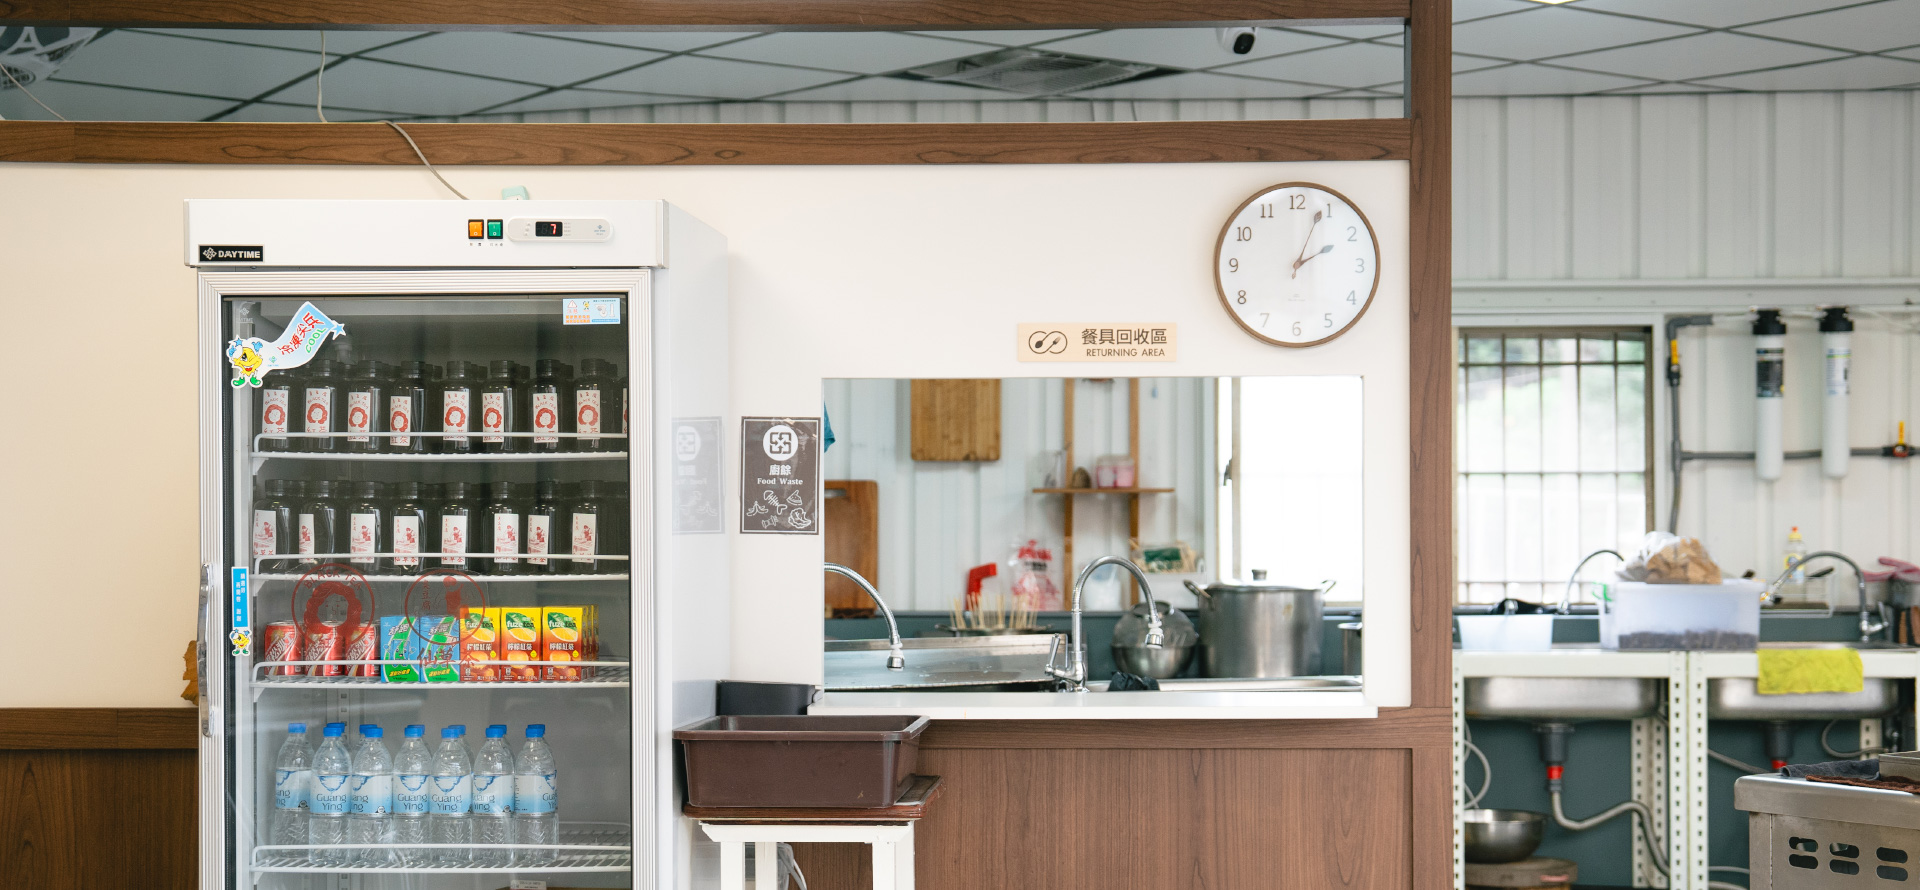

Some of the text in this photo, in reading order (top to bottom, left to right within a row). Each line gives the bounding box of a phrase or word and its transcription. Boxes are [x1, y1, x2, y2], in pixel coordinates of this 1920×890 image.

[1290, 194, 1306, 210] 12
[1260, 204, 1274, 218] 11
[1326, 204, 1332, 218] 1
[550, 224, 557, 234] 7
[1236, 226, 1252, 242] 10
[1346, 226, 1358, 242] 2
[218, 250, 260, 258] DAYTIME
[1229, 258, 1238, 272] 9
[1354, 258, 1365, 273] 3
[1237, 290, 1247, 304] 8
[1346, 290, 1357, 305] 4
[1260, 313, 1270, 328] 7
[1324, 313, 1333, 328] 5
[1082, 328, 1167, 344] 餐具回收區
[1292, 322, 1302, 336] 6
[306, 328, 326, 354] COOL
[1086, 348, 1165, 356] RETURNING AREA
[770, 464, 792, 476] 廚餘
[304, 569, 362, 590] BLACK TEA
[417, 648, 480, 668] 仙草茶
[316, 794, 347, 802] Guang
[398, 793, 428, 802] Guang
[432, 794, 462, 804] Guang
[322, 802, 342, 811] Ying
[403, 802, 423, 812] Ying
[436, 803, 457, 812] Ying
